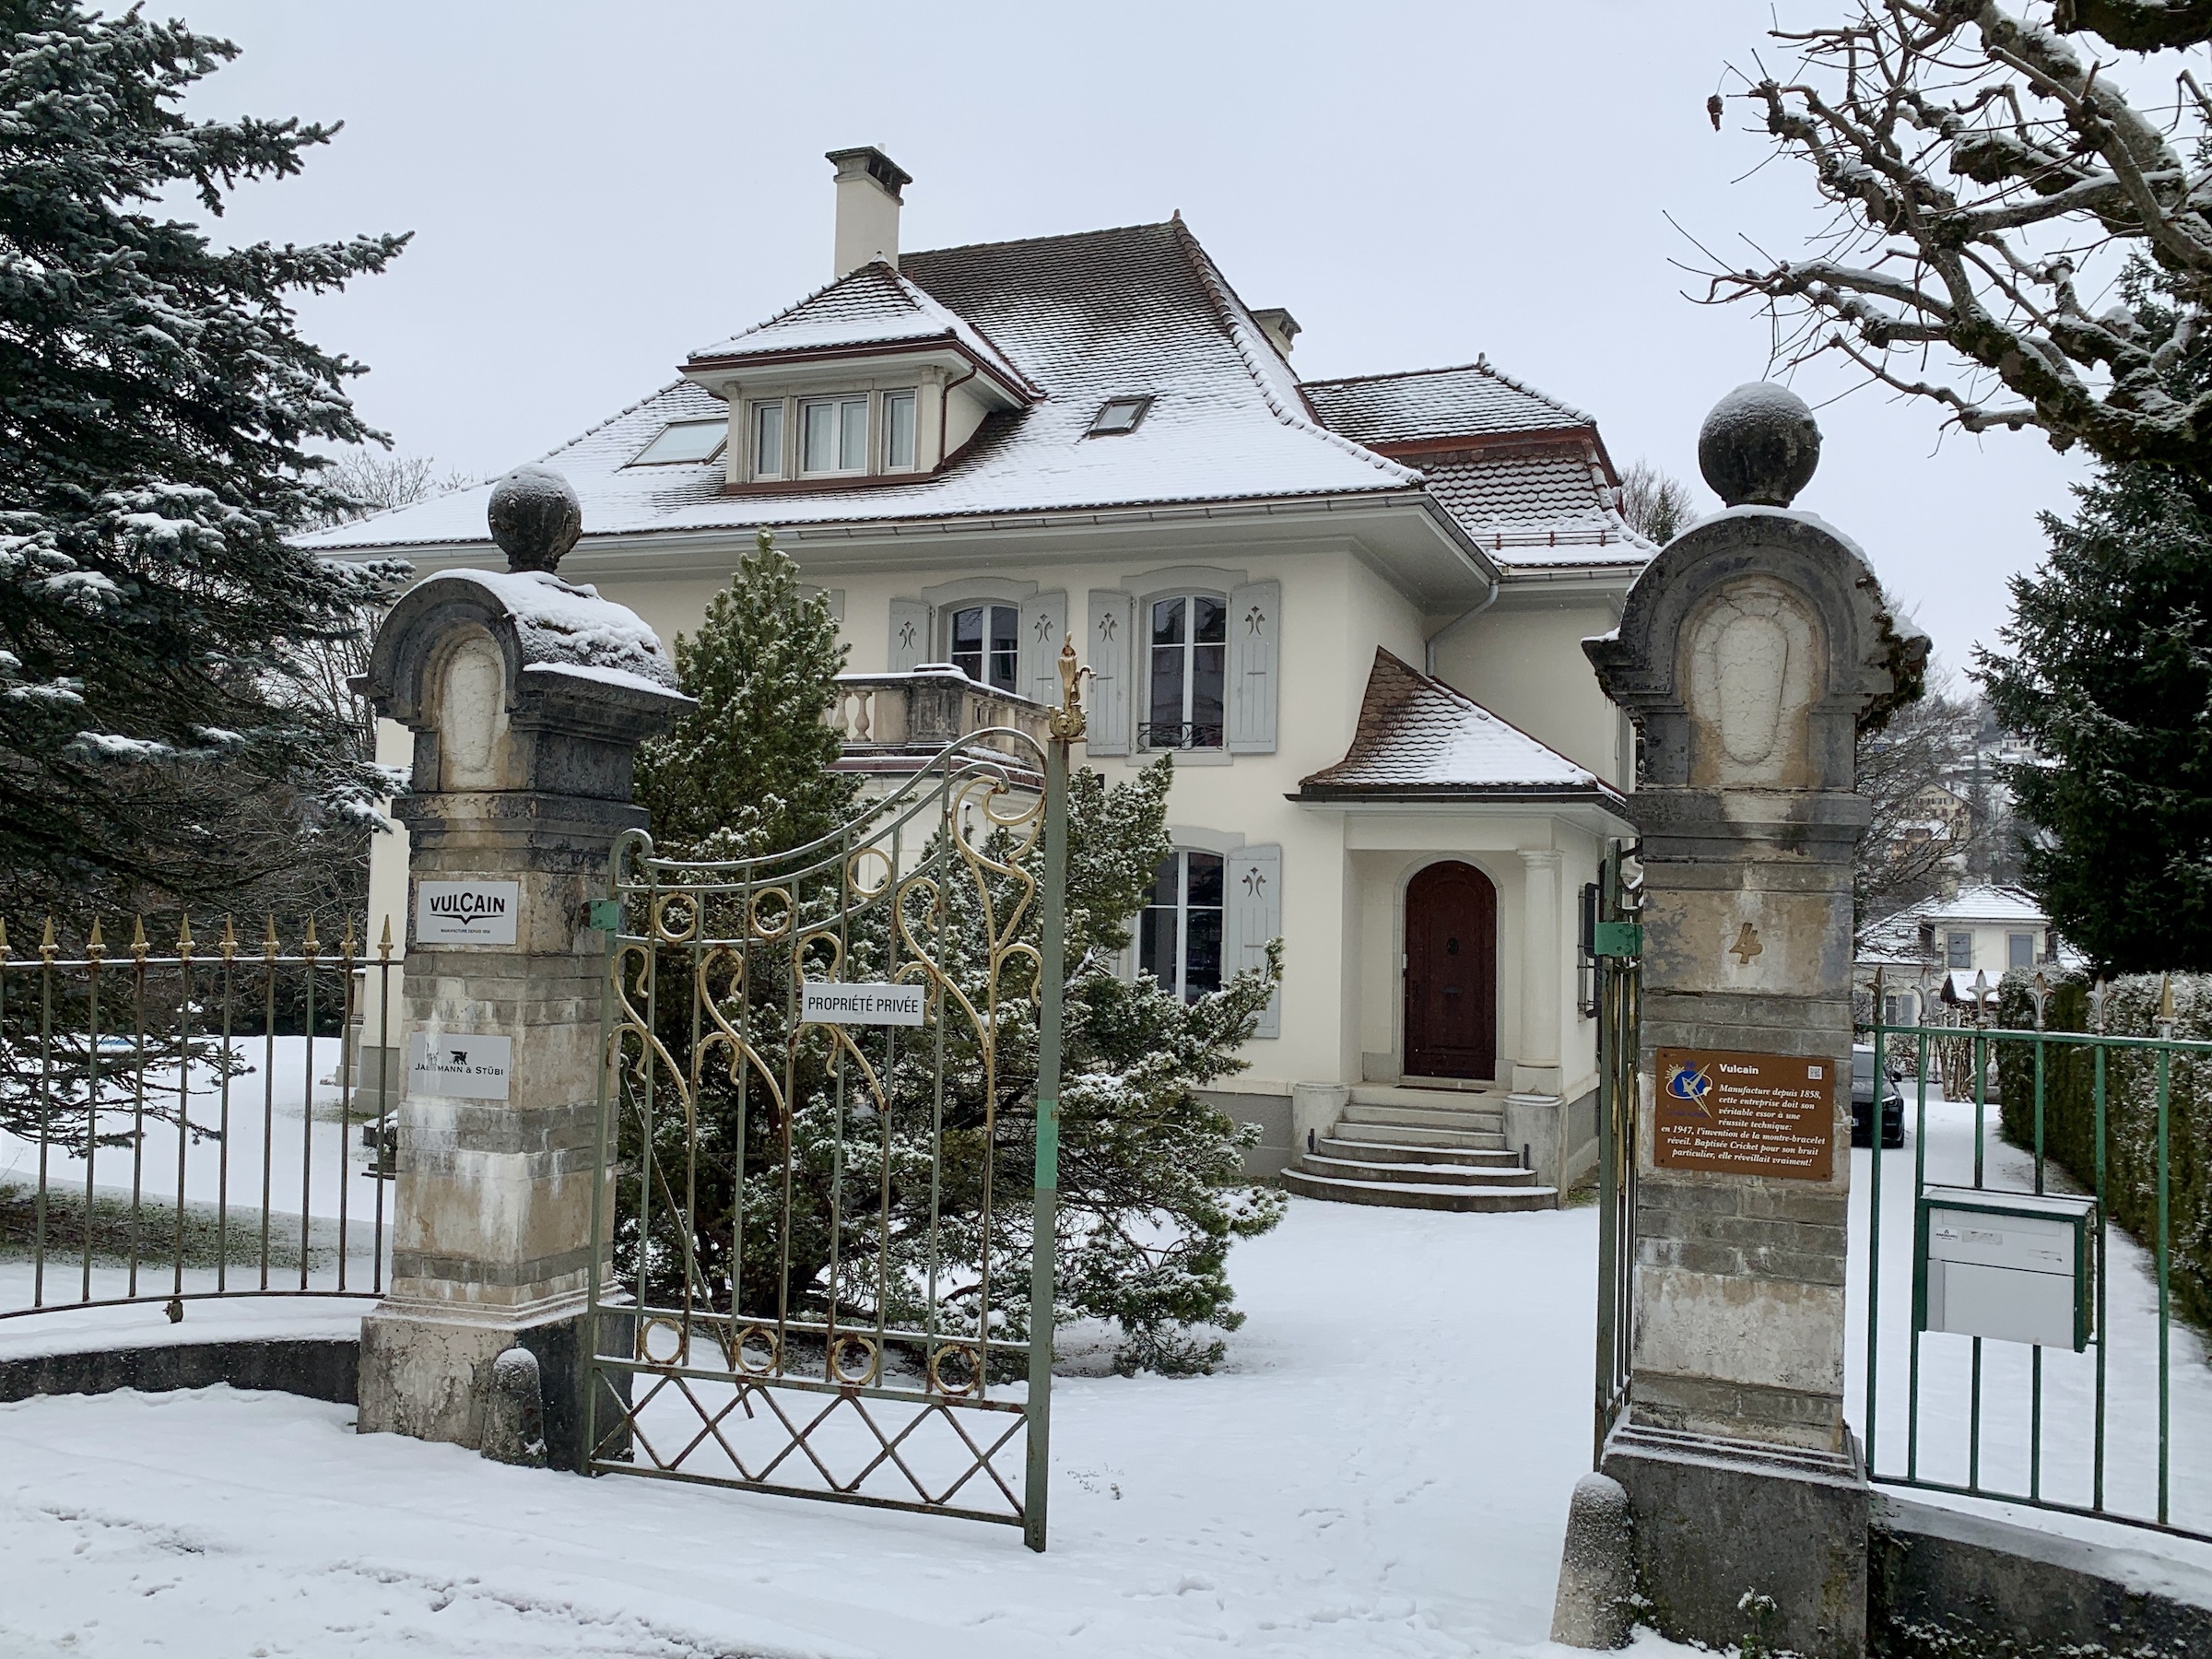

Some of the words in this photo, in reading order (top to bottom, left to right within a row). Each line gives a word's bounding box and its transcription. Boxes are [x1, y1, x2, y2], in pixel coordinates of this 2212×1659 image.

[429, 892, 505, 912] VULCAIN
[1729, 922, 1763, 965] 4
[808, 994, 873, 1012] PROPRIÉTÉ
[877, 996, 918, 1013] PRIVÉE
[476, 1065, 503, 1076] STÜBI
[1719, 1064, 1759, 1075] Vulcain
[1719, 1085, 1770, 1096] Manufacture
[1771, 1088, 1797, 1098] depuis
[1800, 1089, 1822, 1100] 1858,
[1740, 1099, 1780, 1109] entreprise
[1782, 1100, 1798, 1109] doit
[1719, 1108, 1753, 1117] véritable
[1719, 1119, 1748, 1128] réussite
[1751, 1122, 1793, 1132] technique:
[1672, 1125, 1694, 1135] 1947,
[1740, 1131, 1750, 1139] de
[1752, 1132, 1760, 1140] la
[1762, 1134, 1826, 1145] montre-bracelet
[1667, 1137, 1691, 1146] réveil.
[1695, 1139, 1727, 1148] Baptisée
[1730, 1142, 1759, 1150] Cricket
[1760, 1145, 1780, 1153] pour
[1797, 1147, 1818, 1155] bruit
[1672, 1149, 1716, 1159] particulier,
[1718, 1152, 1732, 1160] elle
[1734, 1154, 1771, 1163] réveillait
[1772, 1158, 1812, 1167] vraiment!
